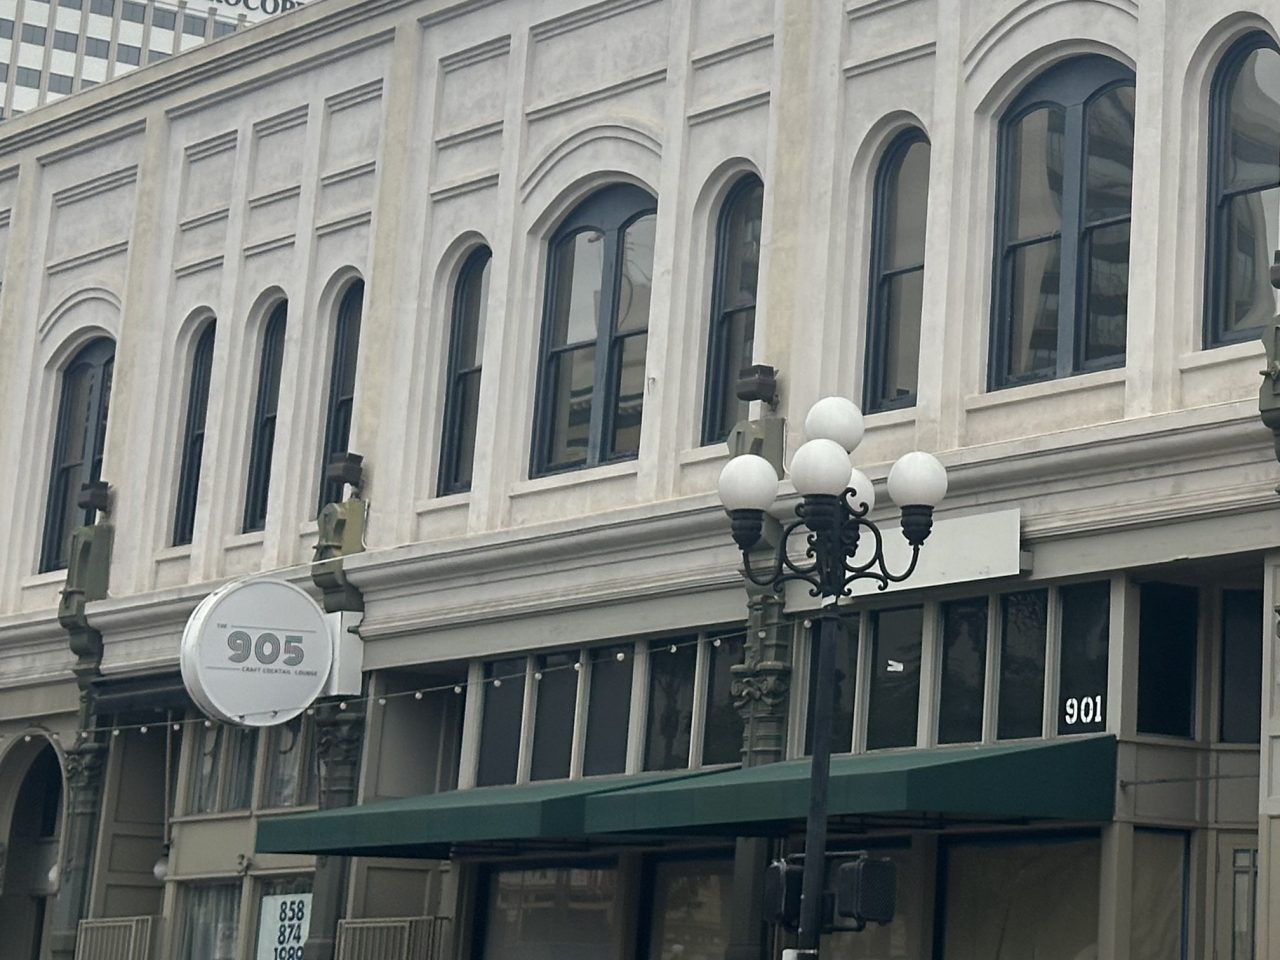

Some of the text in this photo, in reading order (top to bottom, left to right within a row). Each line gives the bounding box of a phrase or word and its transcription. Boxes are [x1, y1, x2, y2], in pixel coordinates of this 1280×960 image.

[227, 630, 304, 666] 905
[1065, 695, 1102, 724] 901
[279, 900, 304, 922] 858
[277, 923, 301, 945] 874
